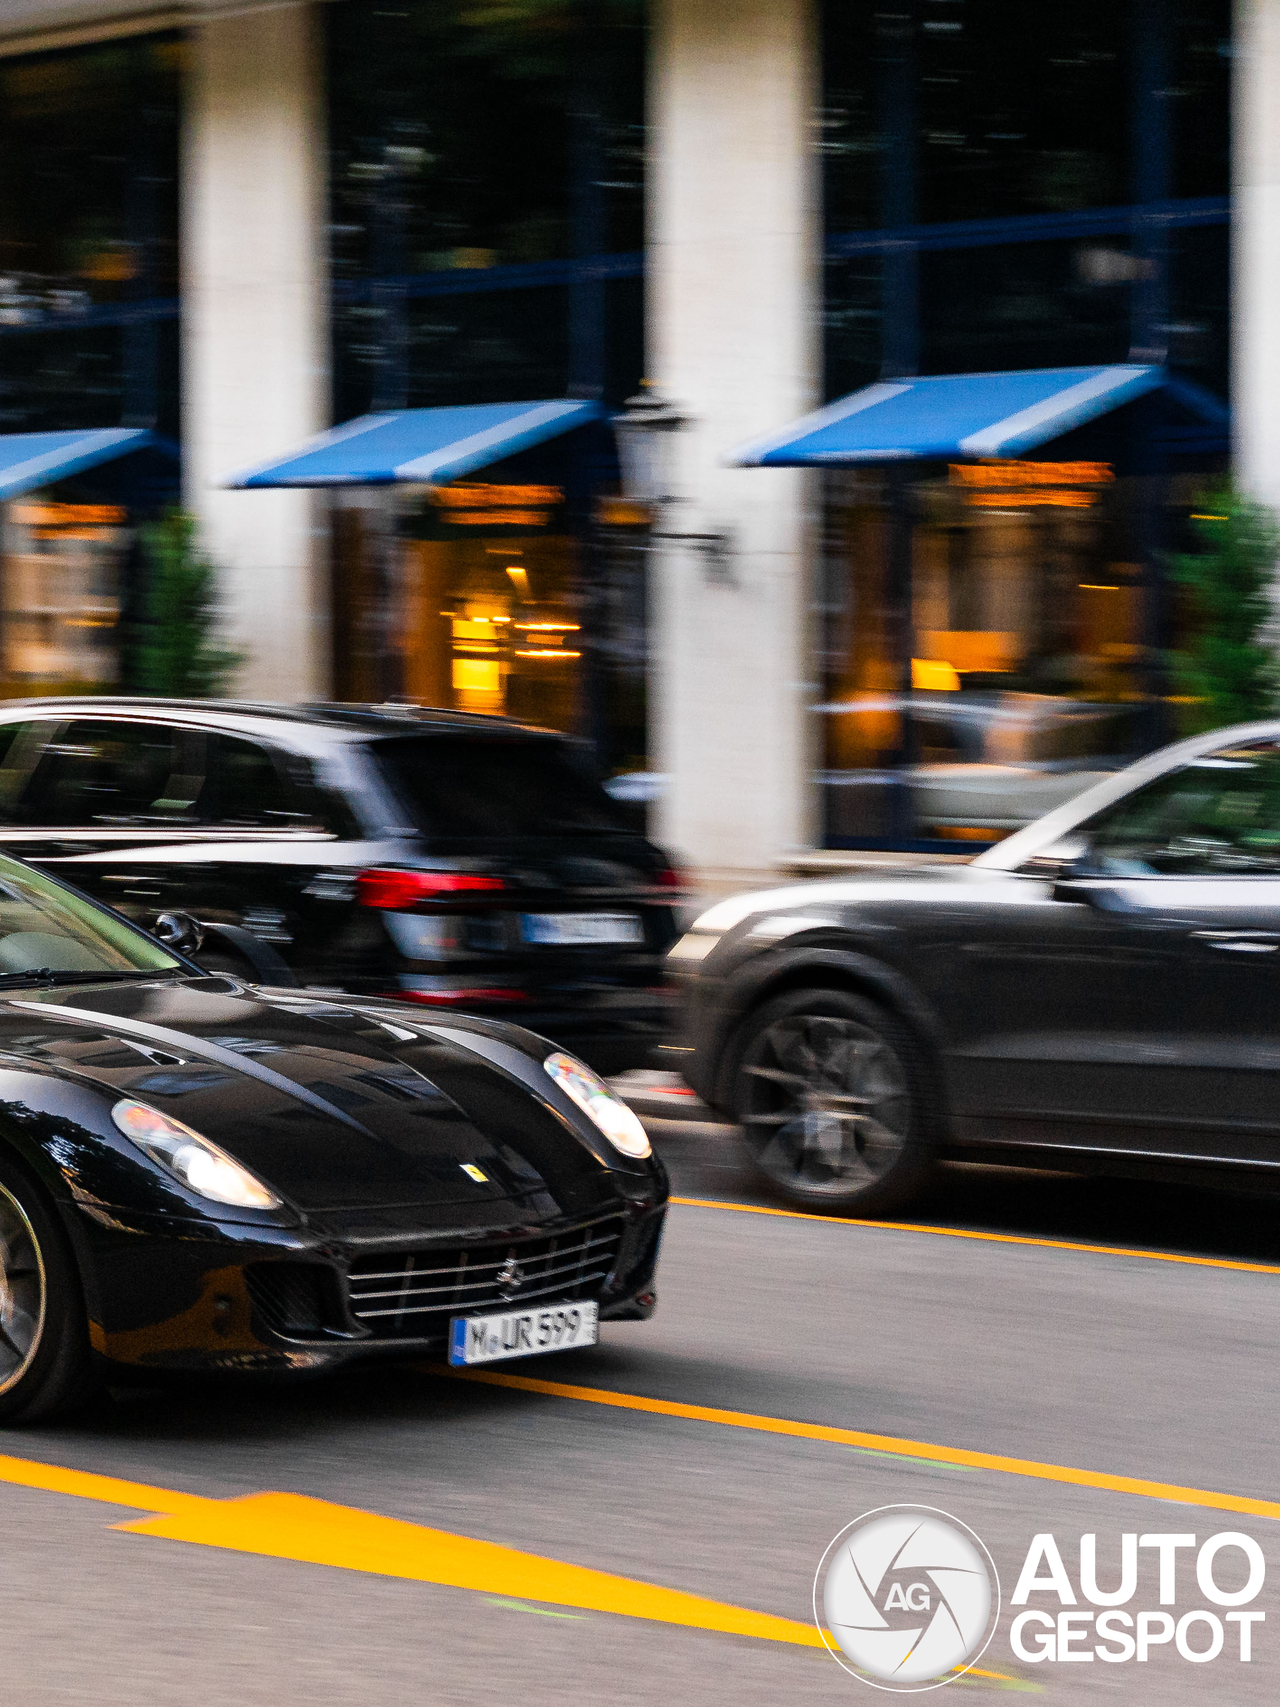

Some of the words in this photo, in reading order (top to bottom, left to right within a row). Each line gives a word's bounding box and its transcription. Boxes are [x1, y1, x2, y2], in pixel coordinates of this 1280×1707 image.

[470, 1321, 488, 1357] M
[501, 1316, 533, 1350] UR
[537, 1309, 582, 1347] 599
